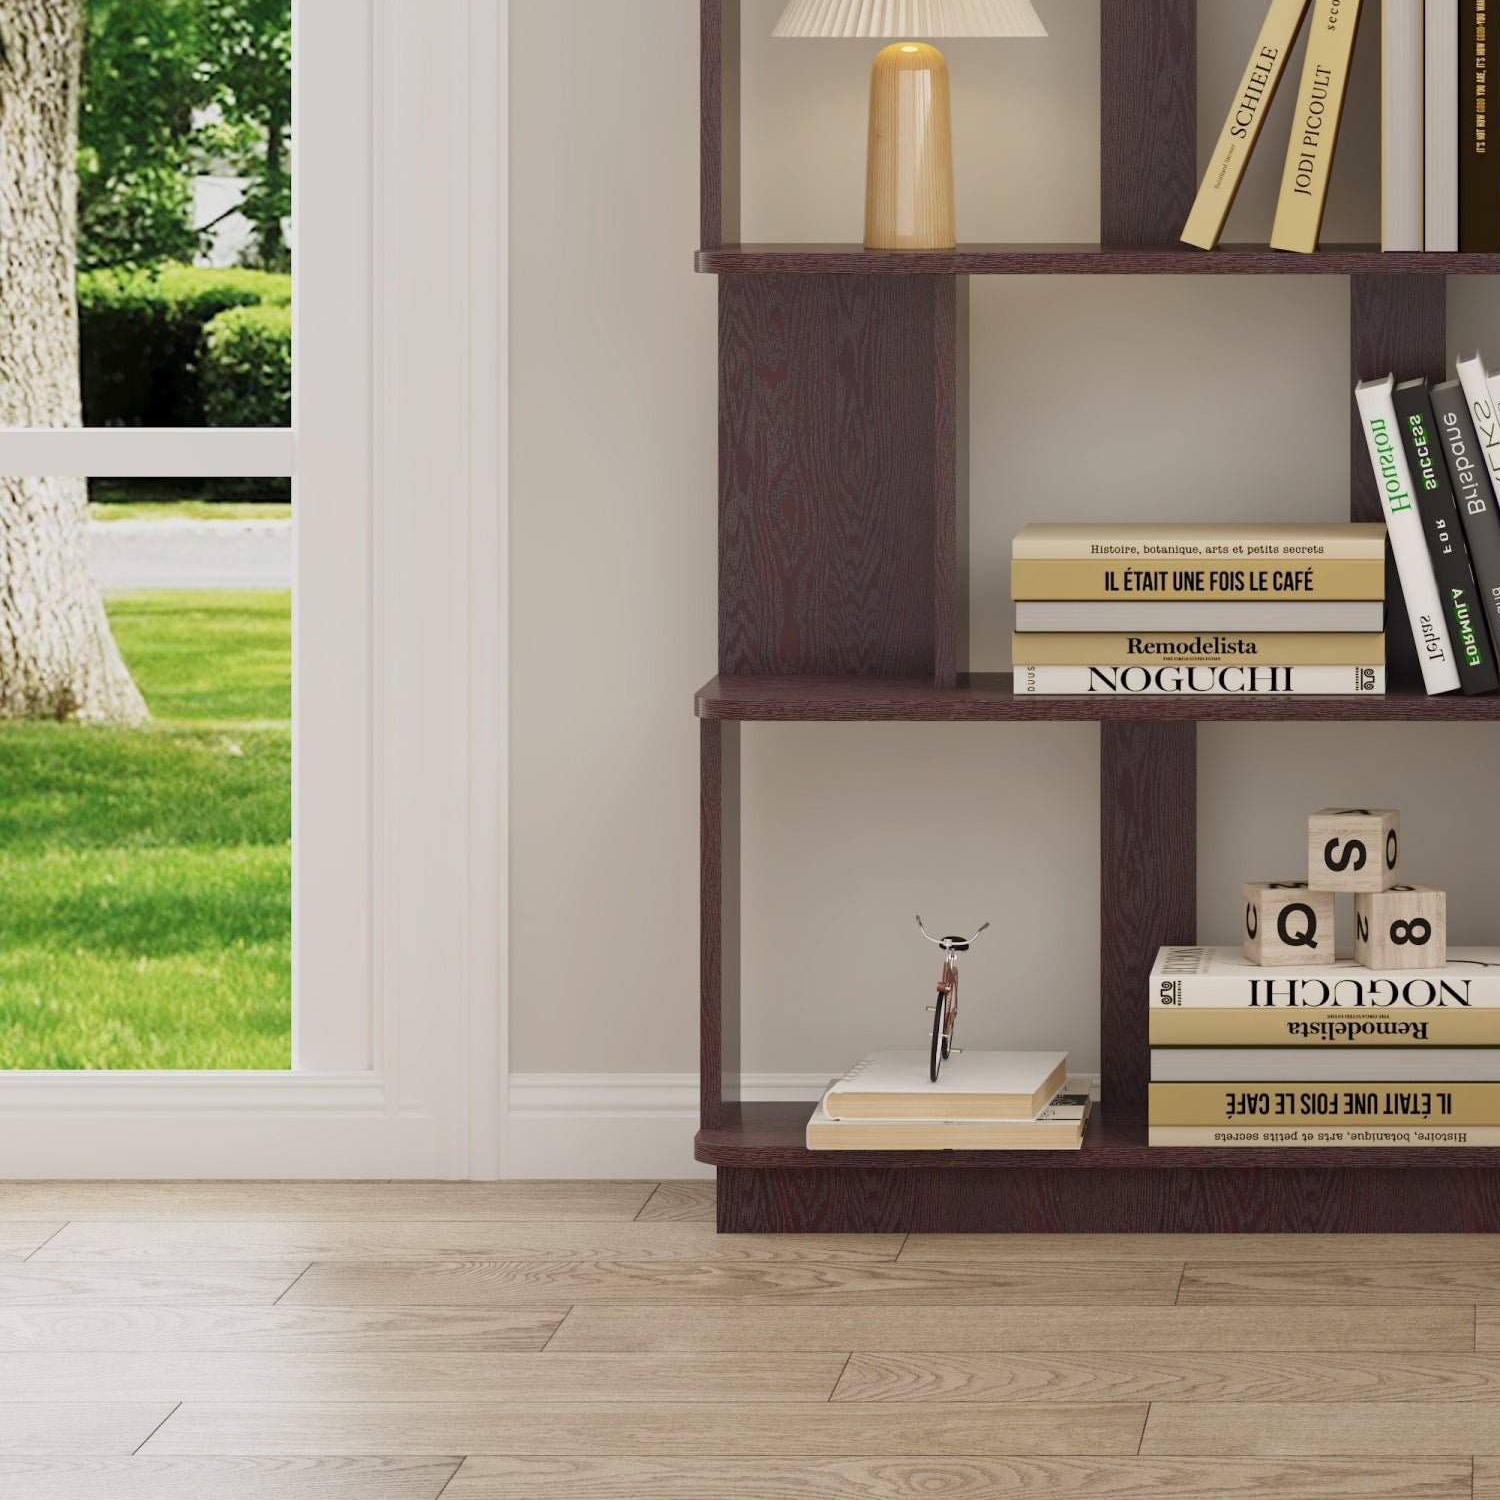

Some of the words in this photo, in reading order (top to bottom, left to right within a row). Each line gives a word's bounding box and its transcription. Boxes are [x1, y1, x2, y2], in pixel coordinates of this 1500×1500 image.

[1230, 45, 1279, 140] SCHIELE
[1302, 63, 1332, 149] PICOULT
[1293, 151, 1317, 197] JODI
[1090, 544, 1140, 556] Histoire,
[1143, 544, 1202, 556] botanique,
[1205, 545, 1229, 554] arts
[1232, 545, 1244, 554] et
[1246, 544, 1280, 556] petits
[1282, 545, 1325, 554] secrets
[1104, 571, 1119, 592] IL
[1123, 567, 1168, 592] ÉTAIT
[1172, 571, 1205, 592] UNE
[1210, 571, 1245, 592] FOIS
[1249, 571, 1268, 592] LE
[1272, 567, 1314, 592] CAFÉ
[1126, 636, 1259, 655] Remodelista
[1026, 665, 1036, 692] DUUS
[1086, 666, 1294, 692] NOGUCHI
[1323, 836, 1367, 873] S
[1277, 902, 1319, 950] Q
[1389, 917, 1432, 946] 8
[1247, 979, 1473, 1008] NOGUCHI
[1287, 1020, 1430, 1040] Remodelista
[1225, 1092, 1270, 1120] CAFÉ
[1274, 1092, 1295, 1115] LE
[1300, 1092, 1339, 1115] FOIS
[1343, 1092, 1378, 1115] UNE
[1383, 1092, 1432, 1120] ÉTAIT
[1436, 1092, 1452, 1115] IL
